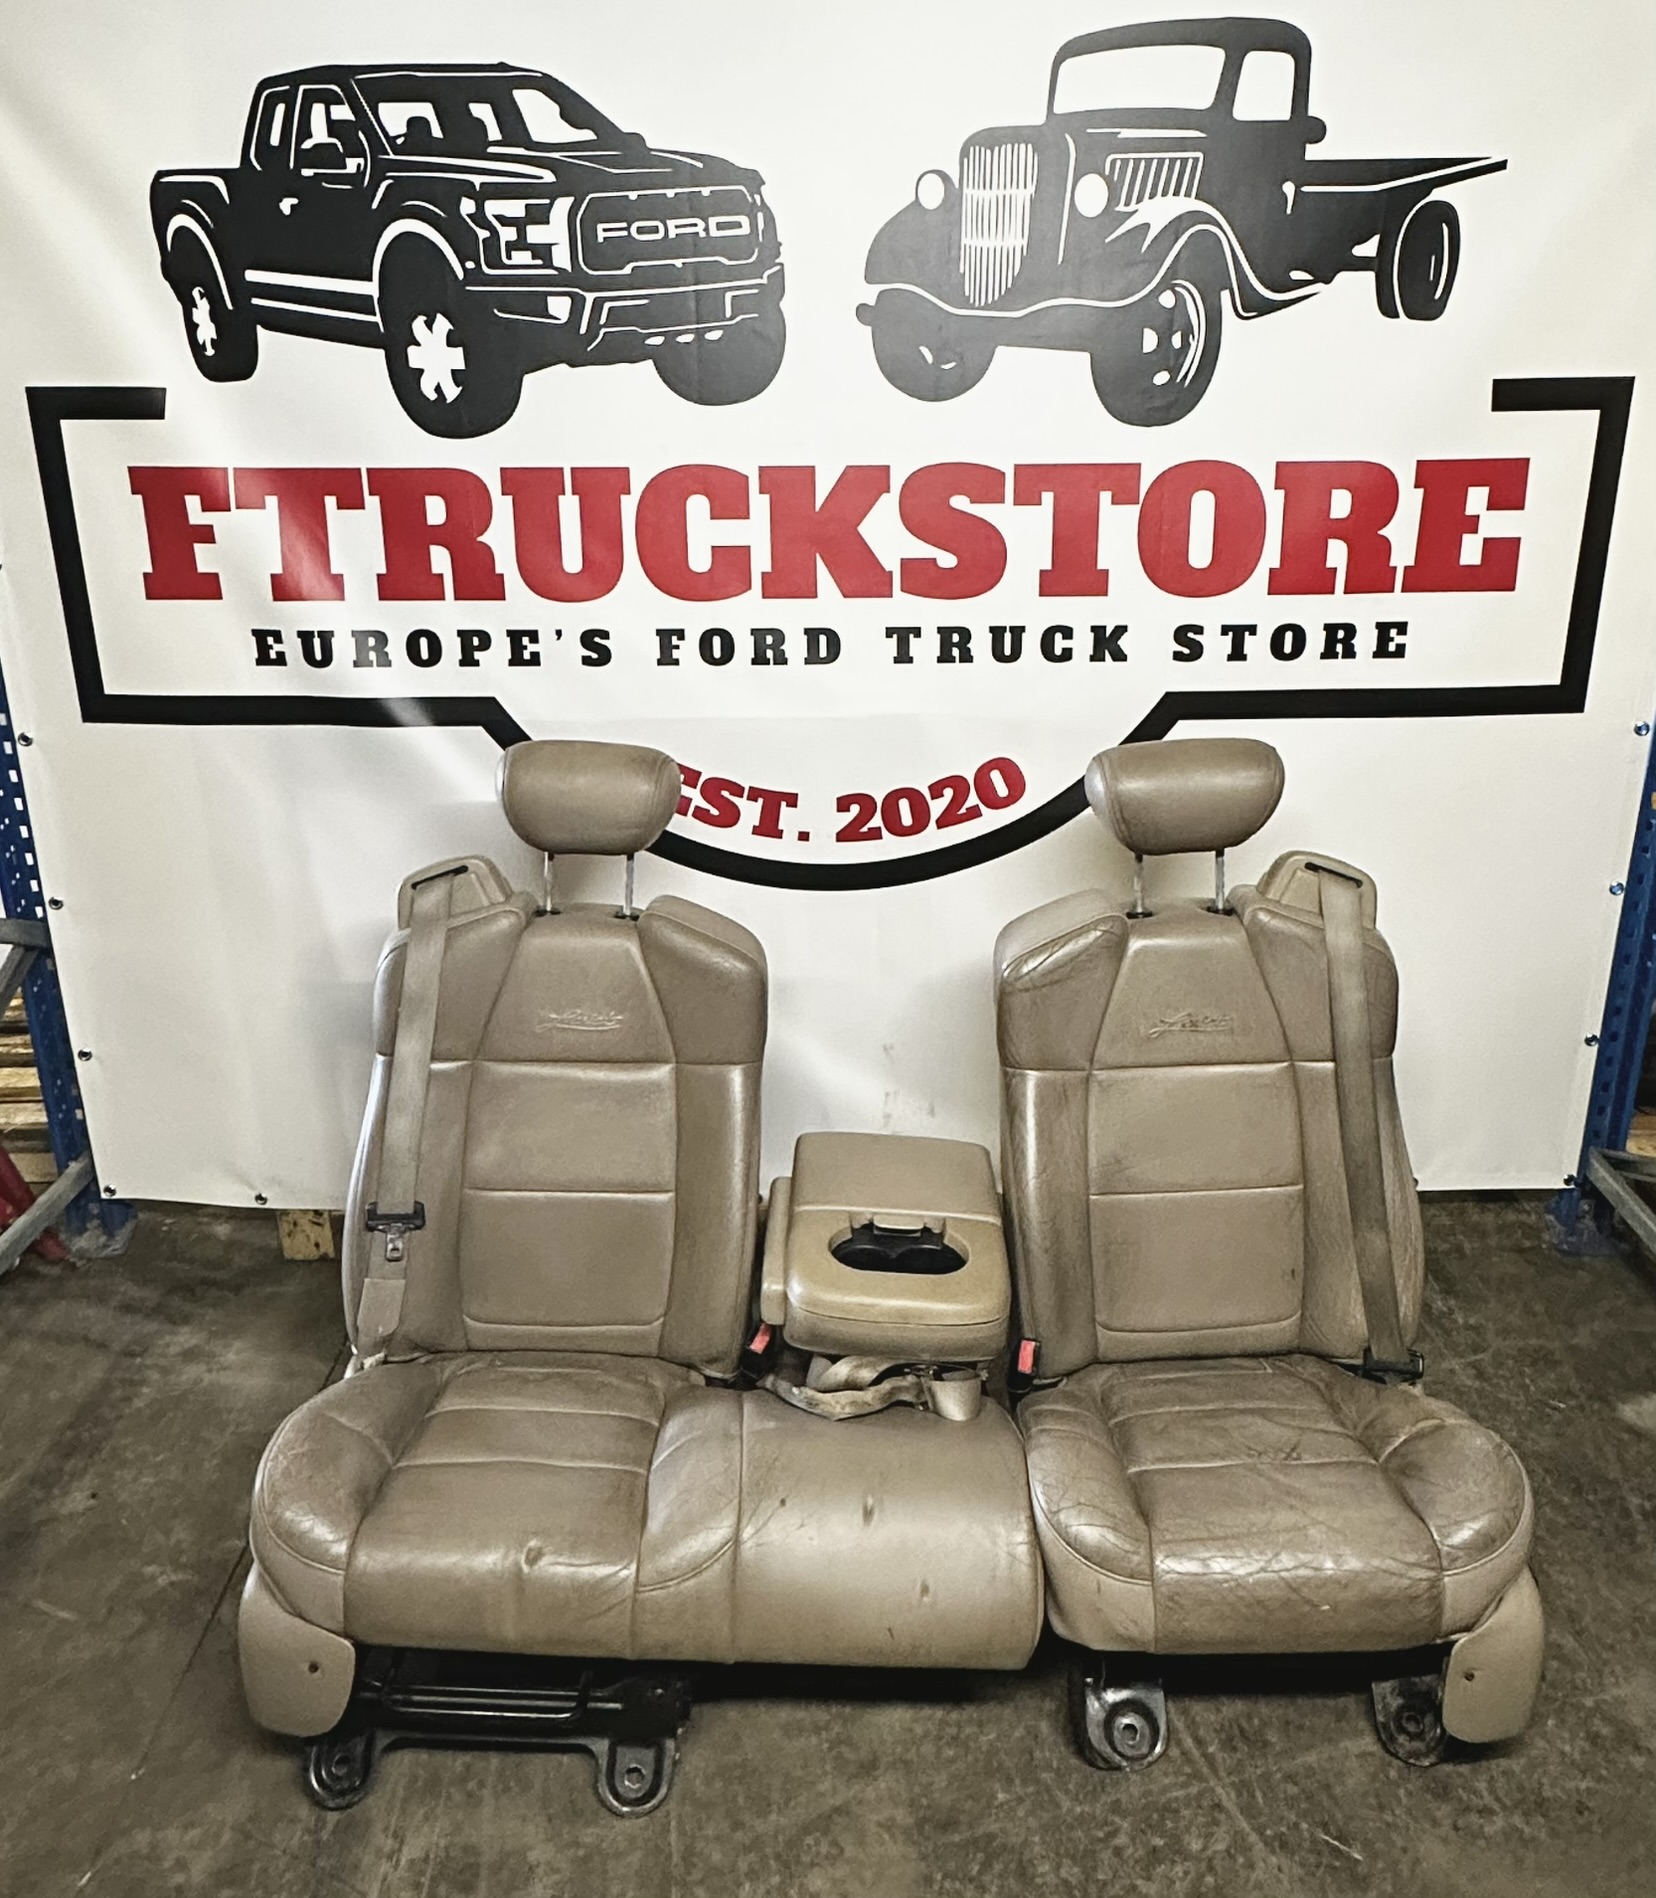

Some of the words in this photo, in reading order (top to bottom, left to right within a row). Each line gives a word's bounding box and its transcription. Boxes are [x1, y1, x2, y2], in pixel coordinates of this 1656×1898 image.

[597, 215, 751, 243] FORD
[128, 458, 1530, 602] FTRUCKSTORE
[251, 629, 612, 668] EUROPE'S
[656, 628, 841, 666] FORD
[886, 625, 1129, 664] TRUCK
[1173, 622, 1409, 662] STORE
[836, 757, 1026, 843] 2020
